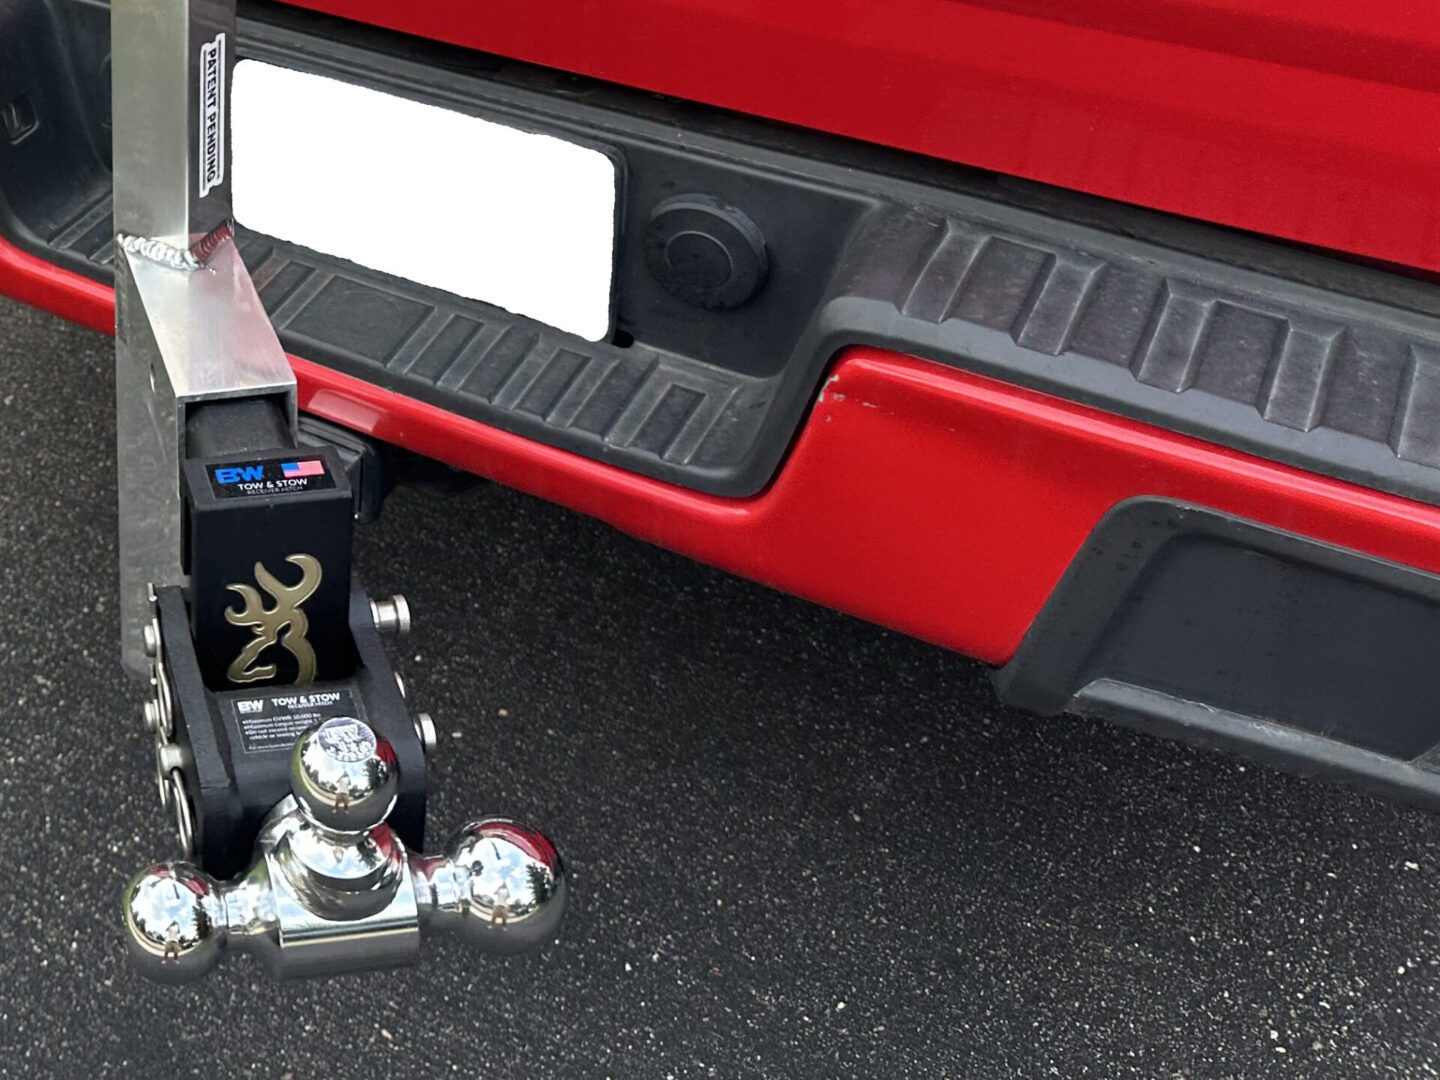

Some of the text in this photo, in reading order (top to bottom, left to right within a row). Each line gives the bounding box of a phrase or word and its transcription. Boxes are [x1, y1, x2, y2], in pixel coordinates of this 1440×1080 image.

[206, 48, 217, 183] PATENT PENDING
[237, 482, 264, 491] TOW
[276, 478, 308, 487] STOW
[271, 696, 297, 707] TOW
[300, 695, 307, 704] &
[309, 692, 340, 702] STOW
